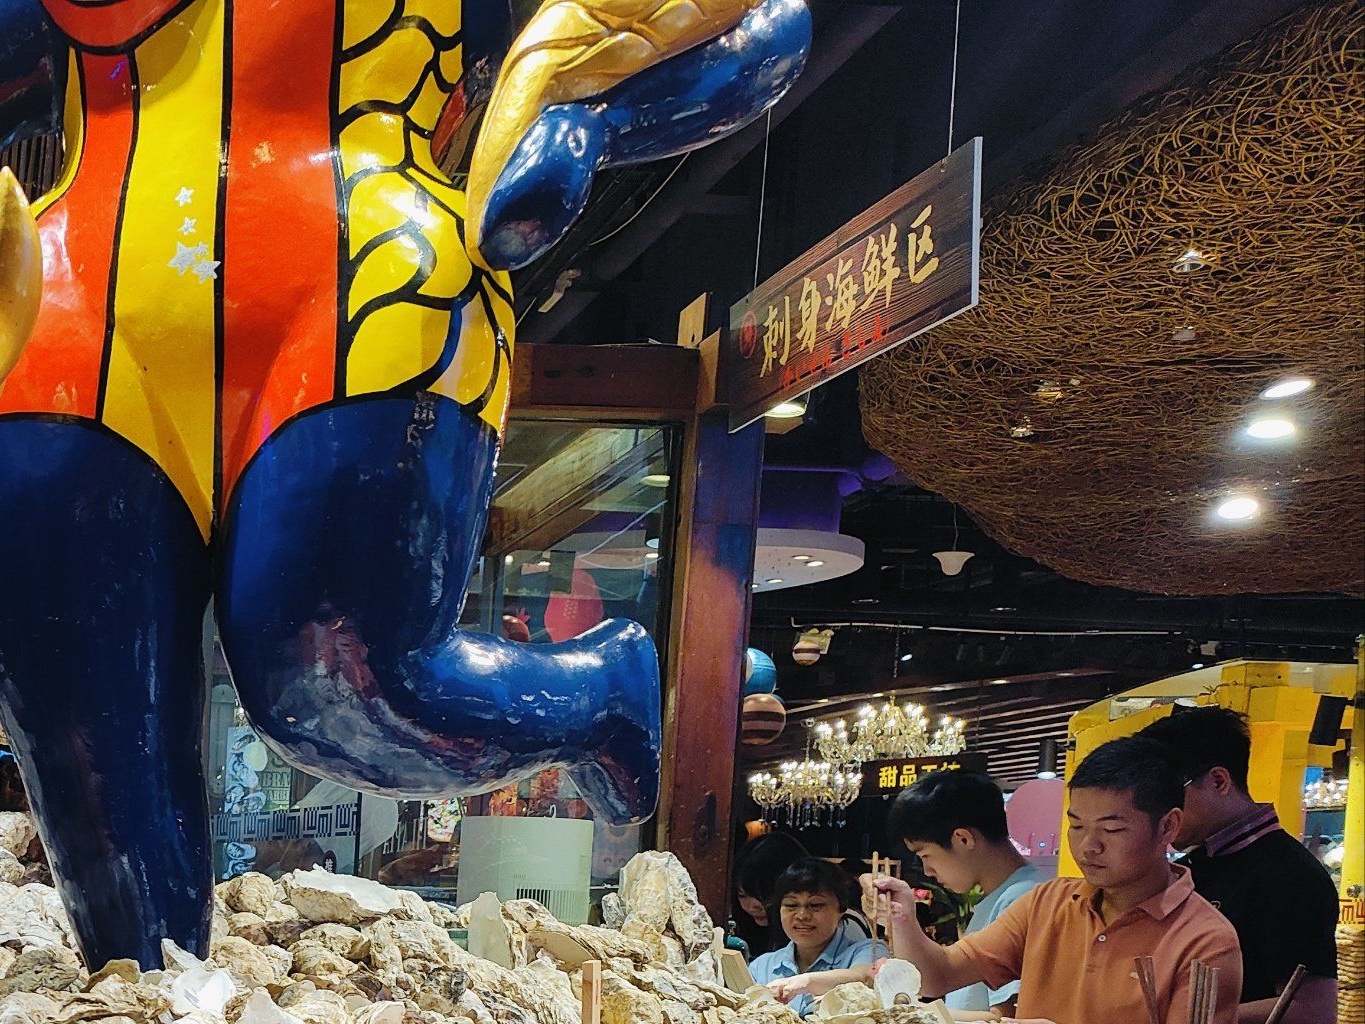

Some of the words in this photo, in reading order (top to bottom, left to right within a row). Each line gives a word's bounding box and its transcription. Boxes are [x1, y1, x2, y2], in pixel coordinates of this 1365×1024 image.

[760, 204, 940, 378] 刺身海鲜区
